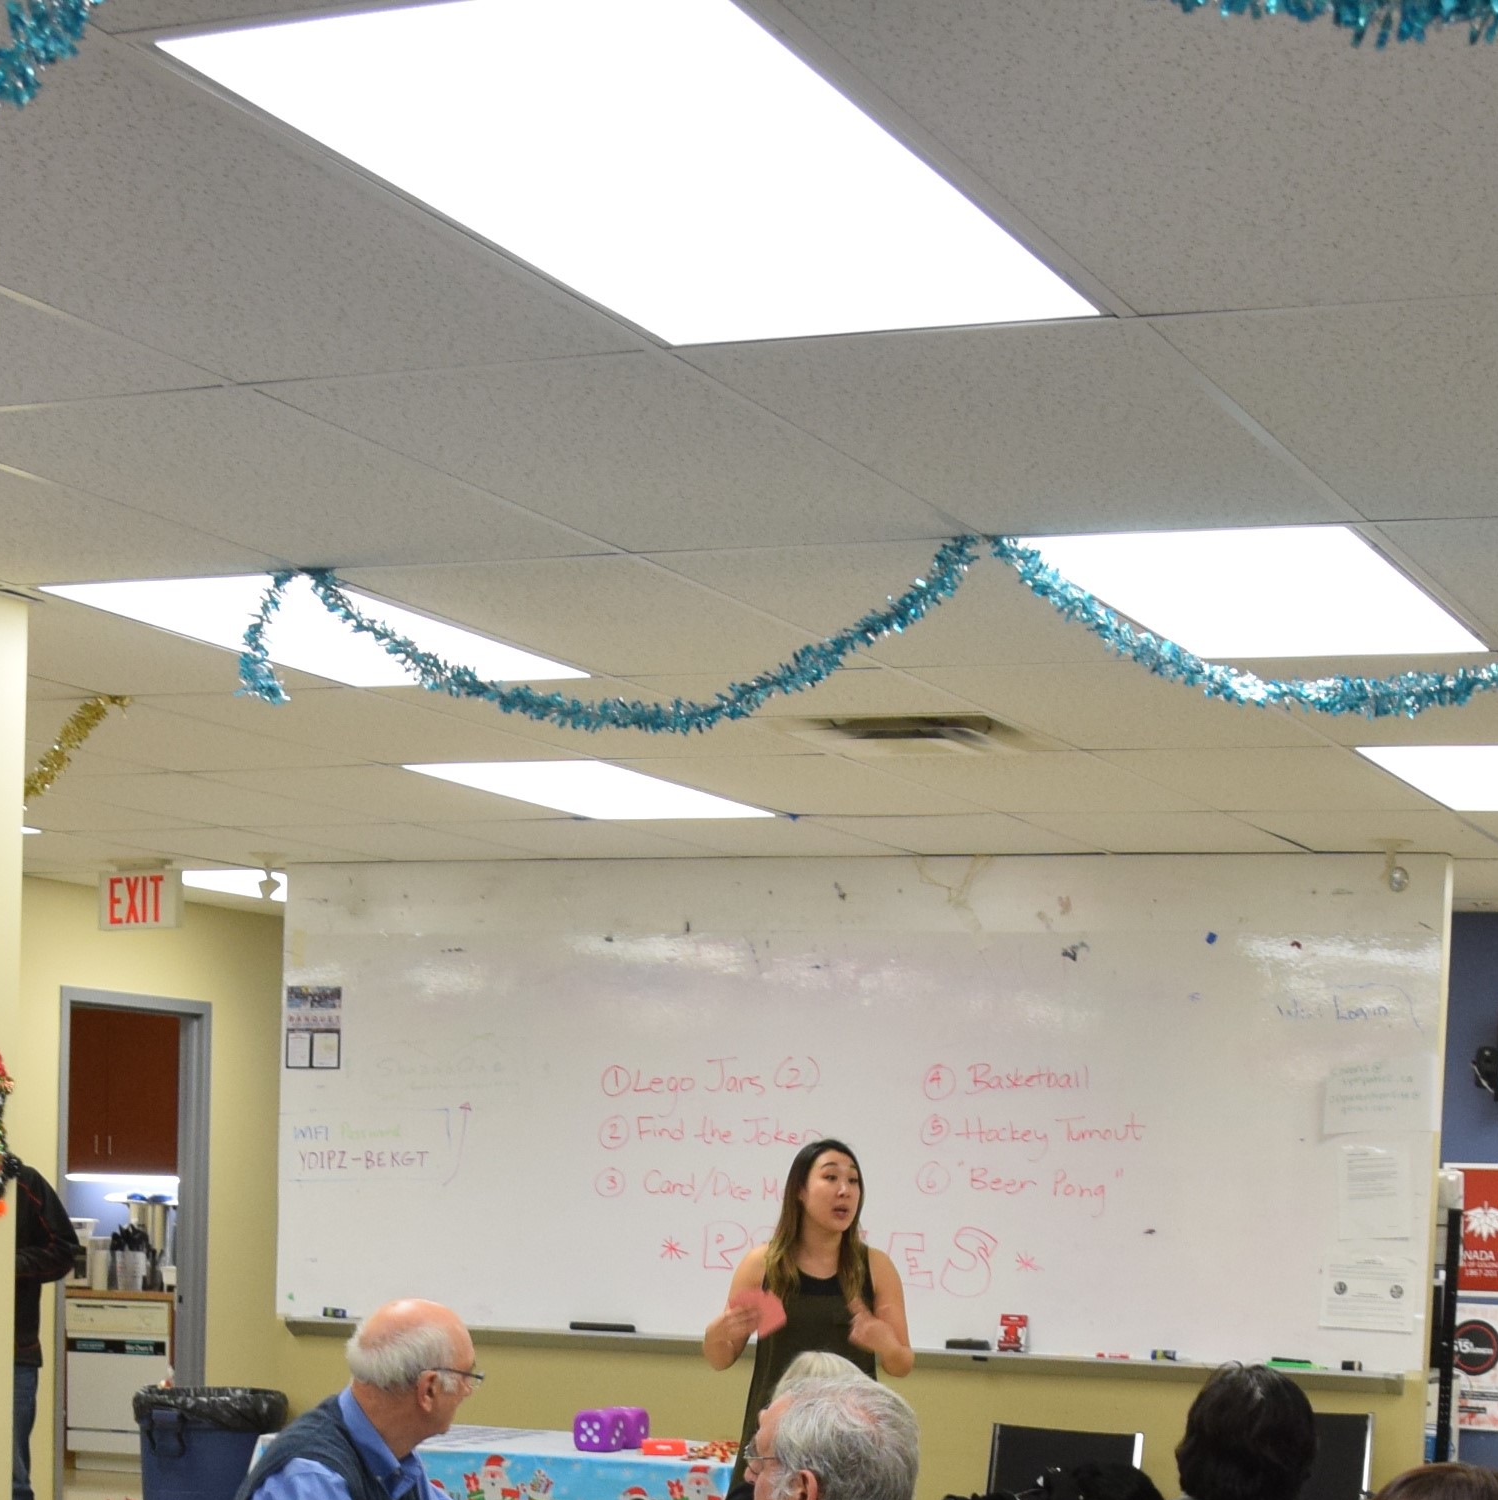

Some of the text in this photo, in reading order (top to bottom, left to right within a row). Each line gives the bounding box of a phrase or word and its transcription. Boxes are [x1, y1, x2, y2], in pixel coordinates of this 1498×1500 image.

[108, 875, 165, 925] EXIT
[633, 1069, 696, 1117] Lego
[704, 1056, 766, 1095] Jars
[965, 1062, 1090, 1095] Basketball
[637, 1115, 685, 1142] Find
[694, 1115, 733, 1145] the
[955, 1116, 1049, 1162] Hockey
[1462, 1249, 1496, 1262] NADA
